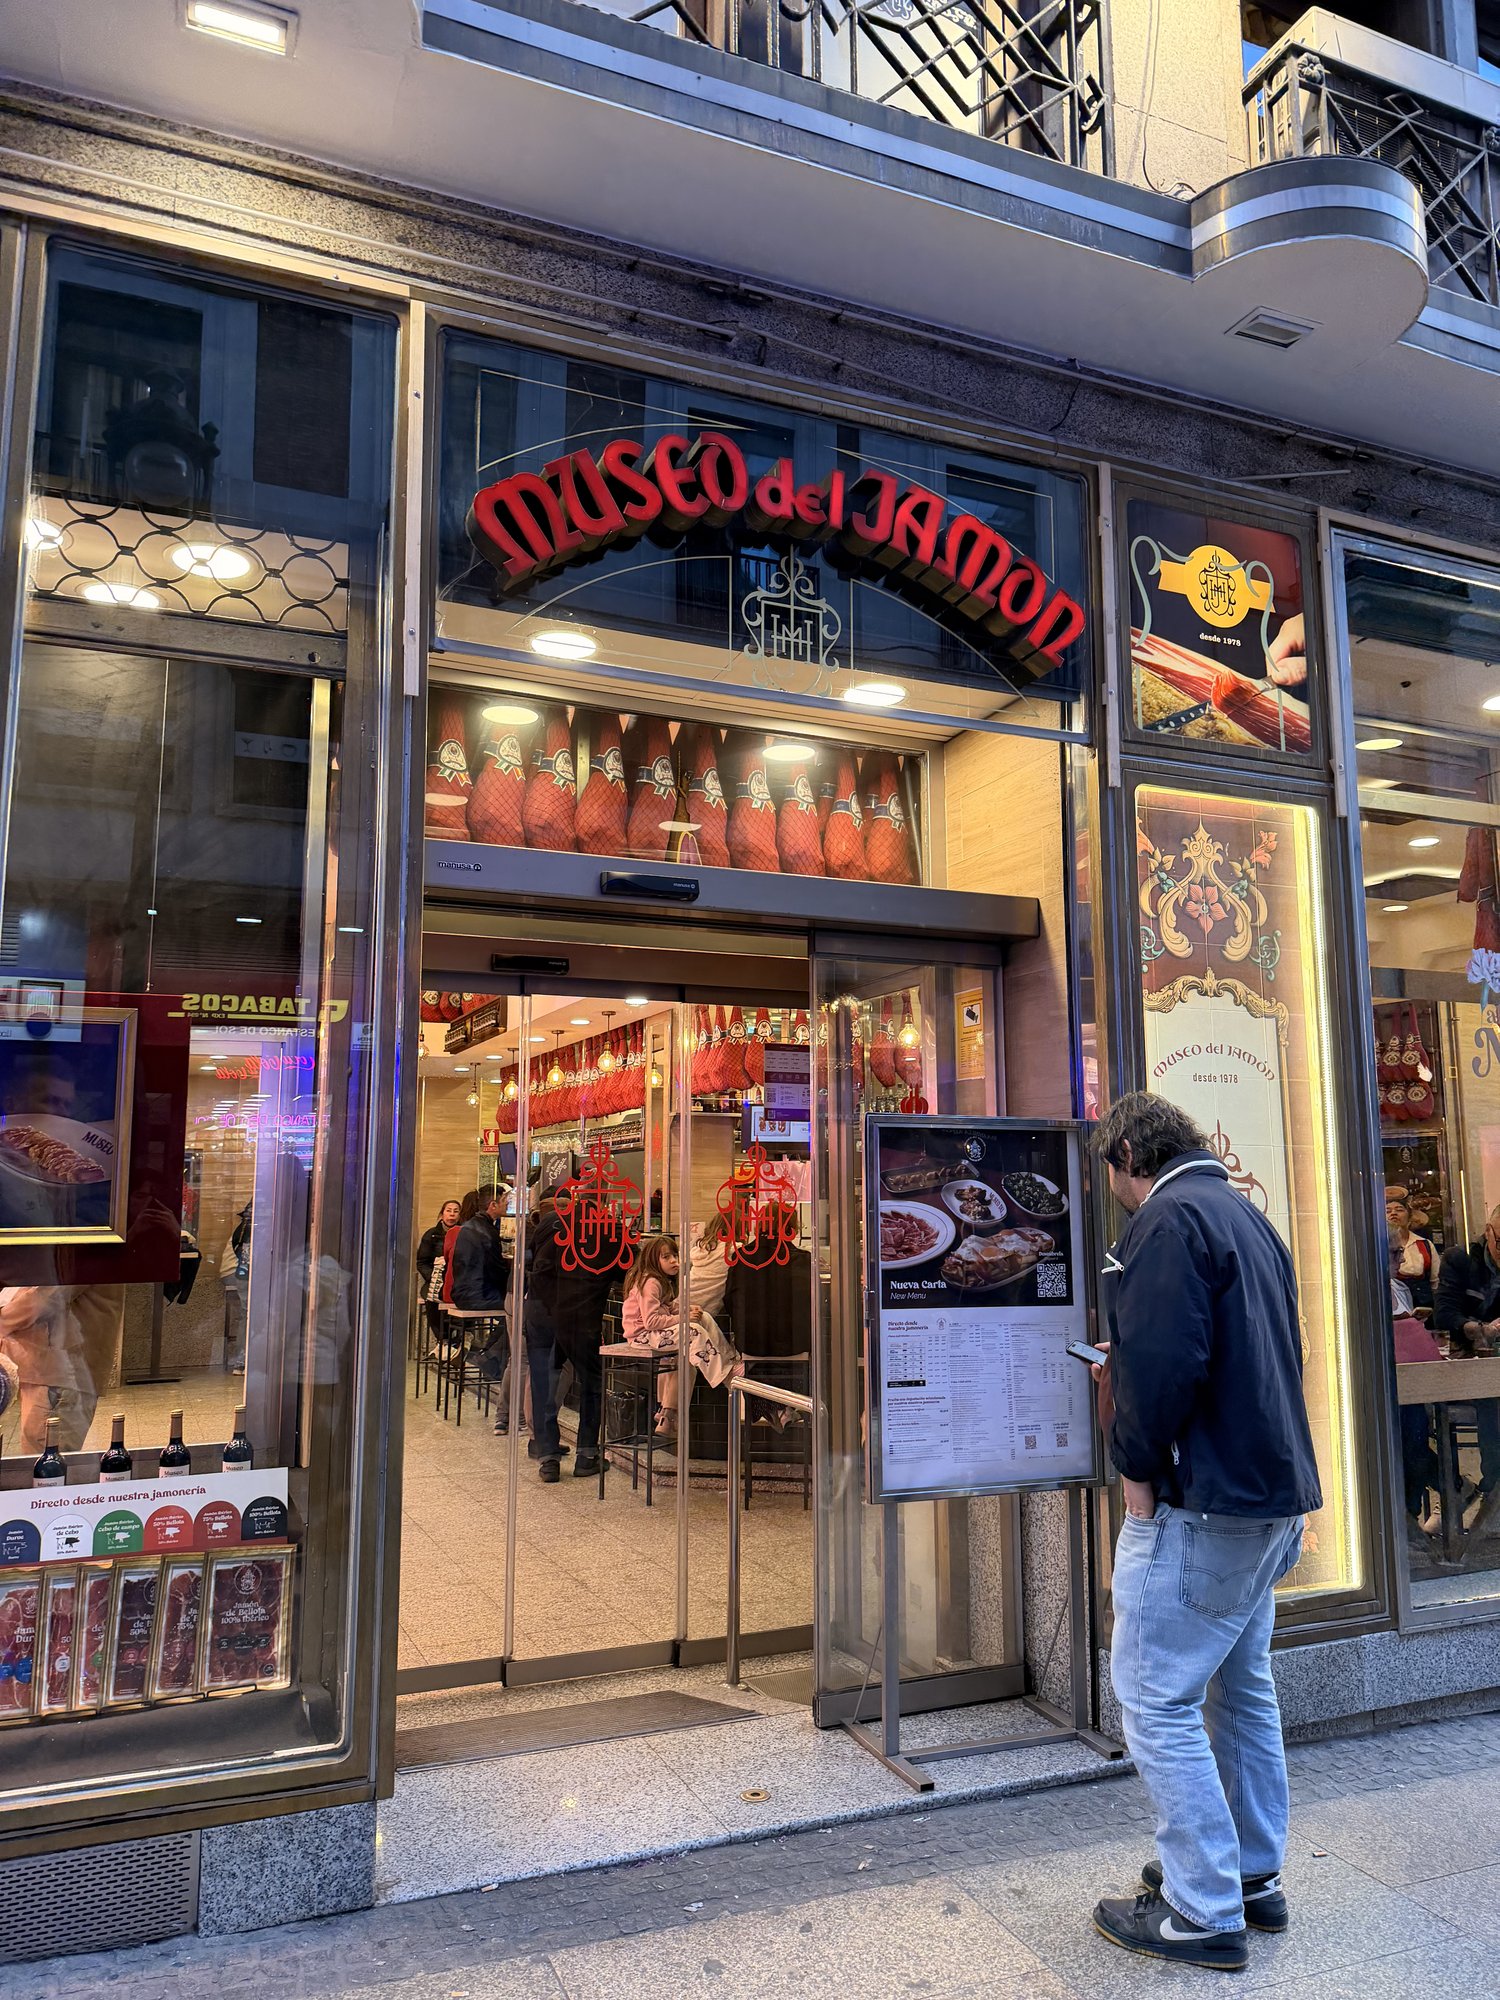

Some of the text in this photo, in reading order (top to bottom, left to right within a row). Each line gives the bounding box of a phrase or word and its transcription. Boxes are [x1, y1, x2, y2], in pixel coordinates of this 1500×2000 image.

[473, 431, 748, 577] MUSEO
[755, 457, 845, 530] del
[1199, 632, 1242, 647] desde 1978
[438, 861, 472, 871] manusa
[1153, 1044, 1202, 1079] MUSEO
[1205, 1043, 1224, 1055] del
[1193, 1073, 1239, 1084] desde 1978
[890, 1280, 947, 1290] Nueva Carta
[890, 1291, 926, 1300] New Menu
[30, 1485, 207, 1509] Directo desde nuestra jamonería
[238, 1607, 266, 1616] Bellota
[221, 1616, 241, 1625] 100%
[14, 1626, 35, 1634] Jam
[129, 1628, 147, 1636] 50%
[61, 1636, 72, 1644] 50
